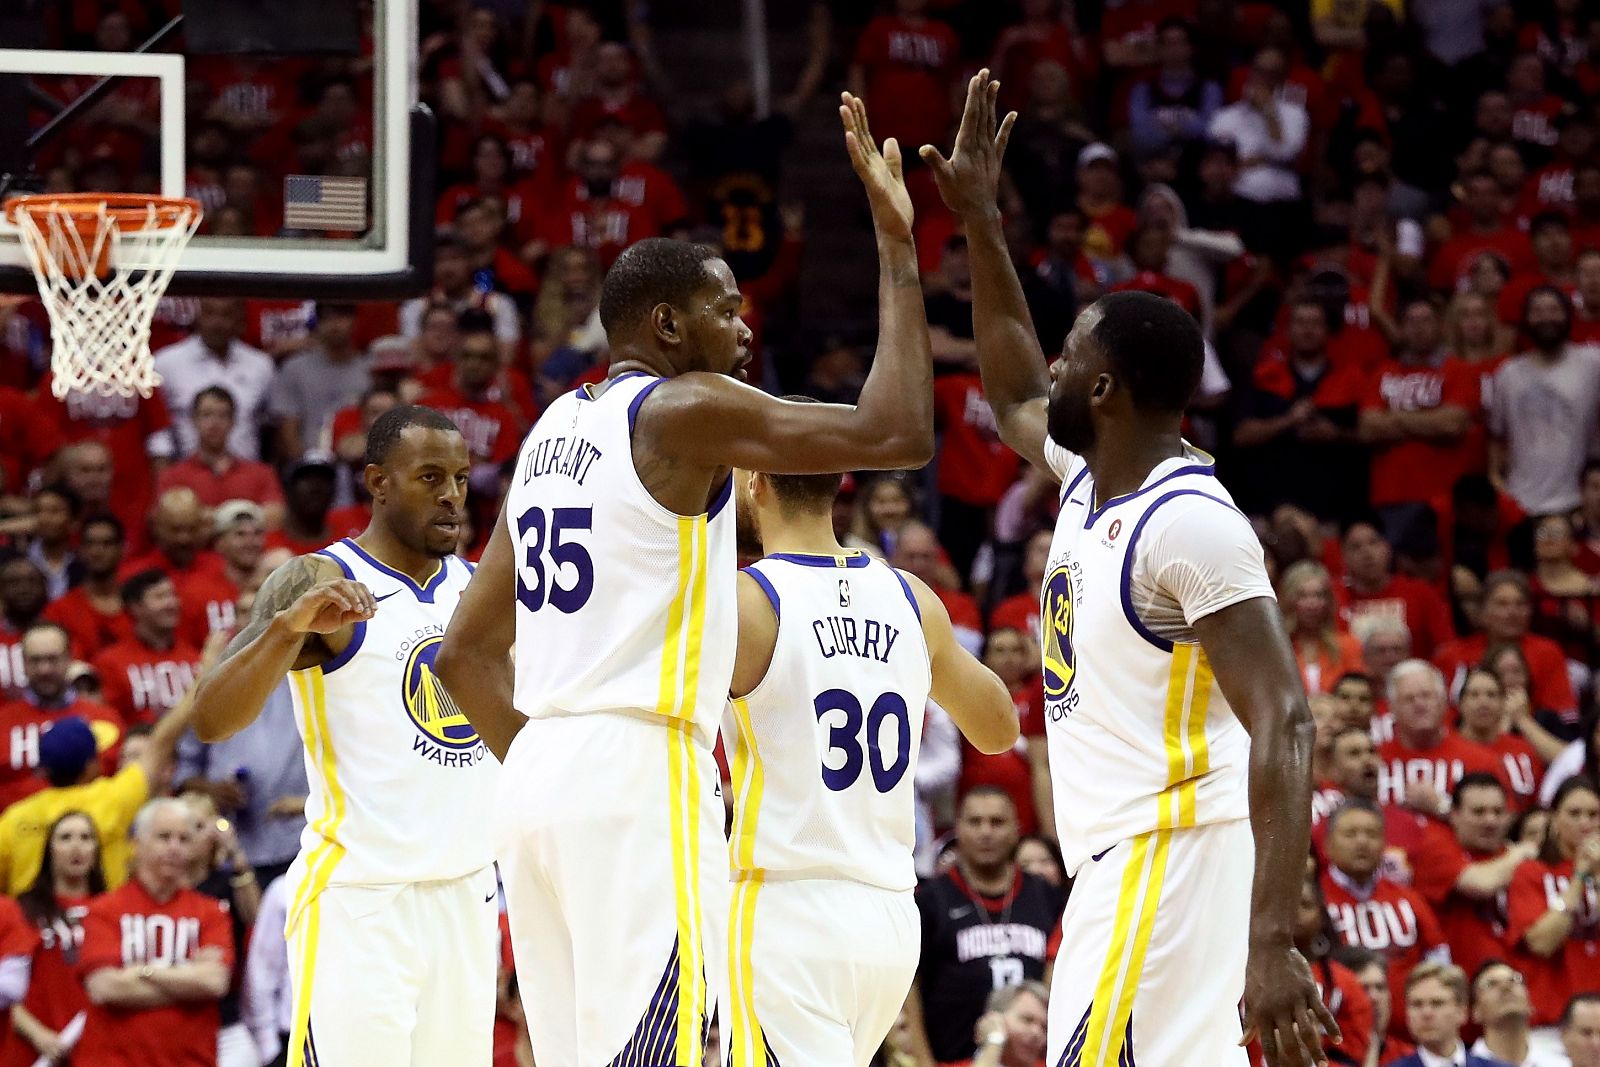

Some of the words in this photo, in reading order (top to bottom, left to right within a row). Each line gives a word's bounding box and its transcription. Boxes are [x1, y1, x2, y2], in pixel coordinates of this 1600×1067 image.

[524, 435, 602, 486] DURANT
[516, 503, 594, 614] 35
[1070, 561, 1083, 608] STATE
[1054, 593, 1070, 635] 23
[395, 624, 444, 661] GOLDEN
[812, 616, 900, 663] CURRY
[813, 688, 911, 793] 30
